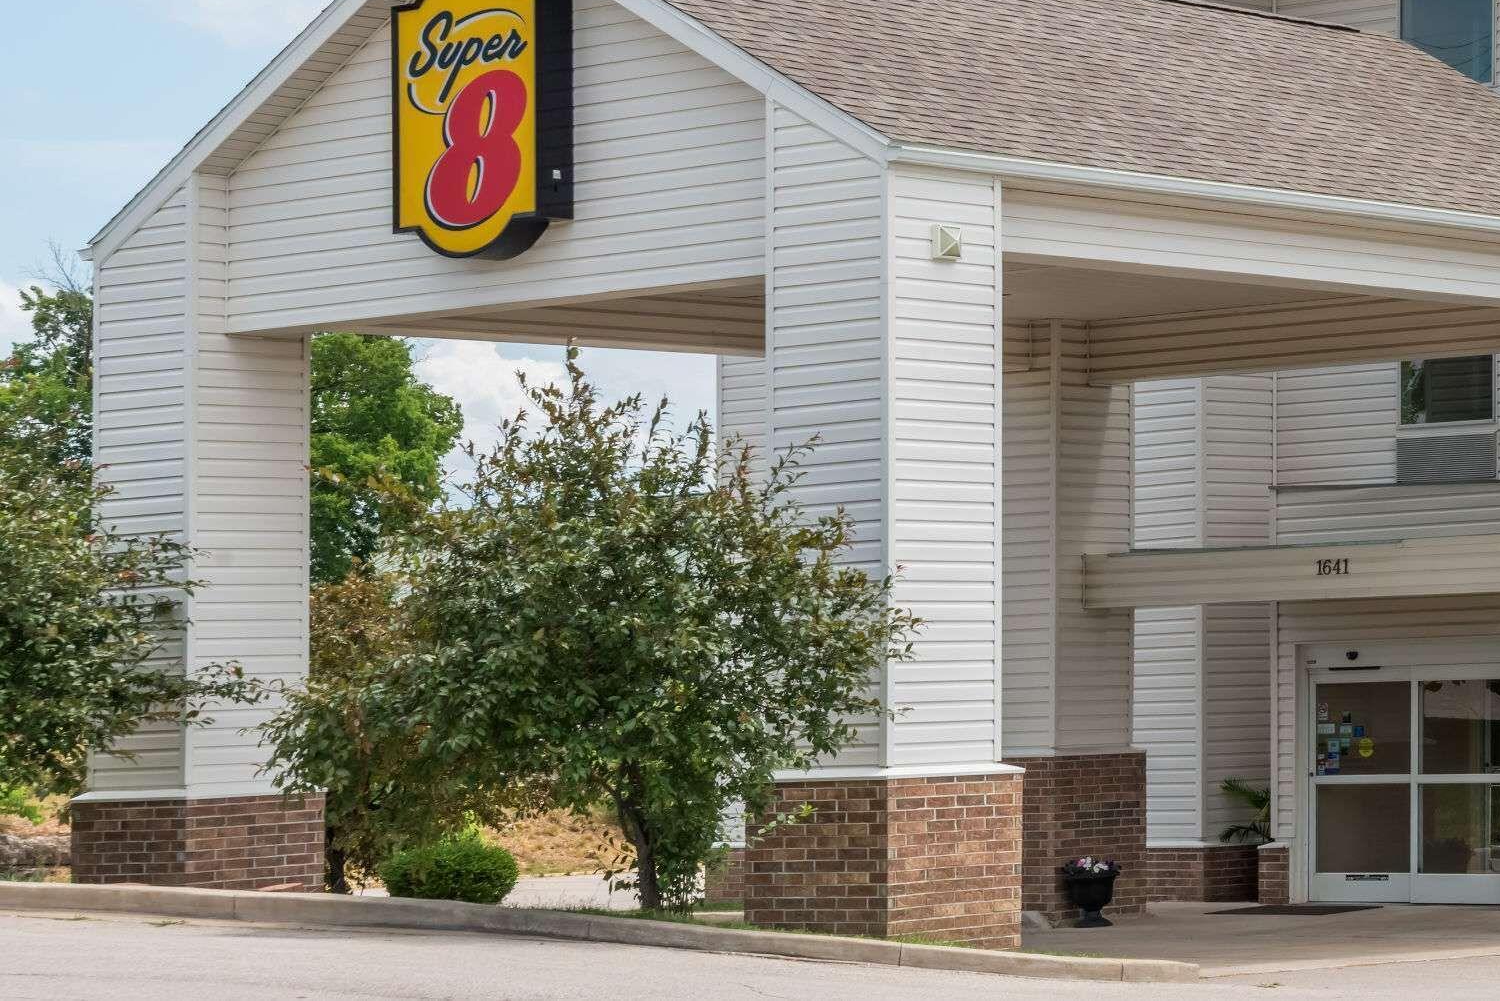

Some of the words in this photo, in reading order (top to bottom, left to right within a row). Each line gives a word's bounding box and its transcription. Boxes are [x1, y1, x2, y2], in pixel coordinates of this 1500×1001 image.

[408, 9, 528, 104] Super
[424, 69, 528, 231] 8
[1315, 558, 1349, 576] 1641
